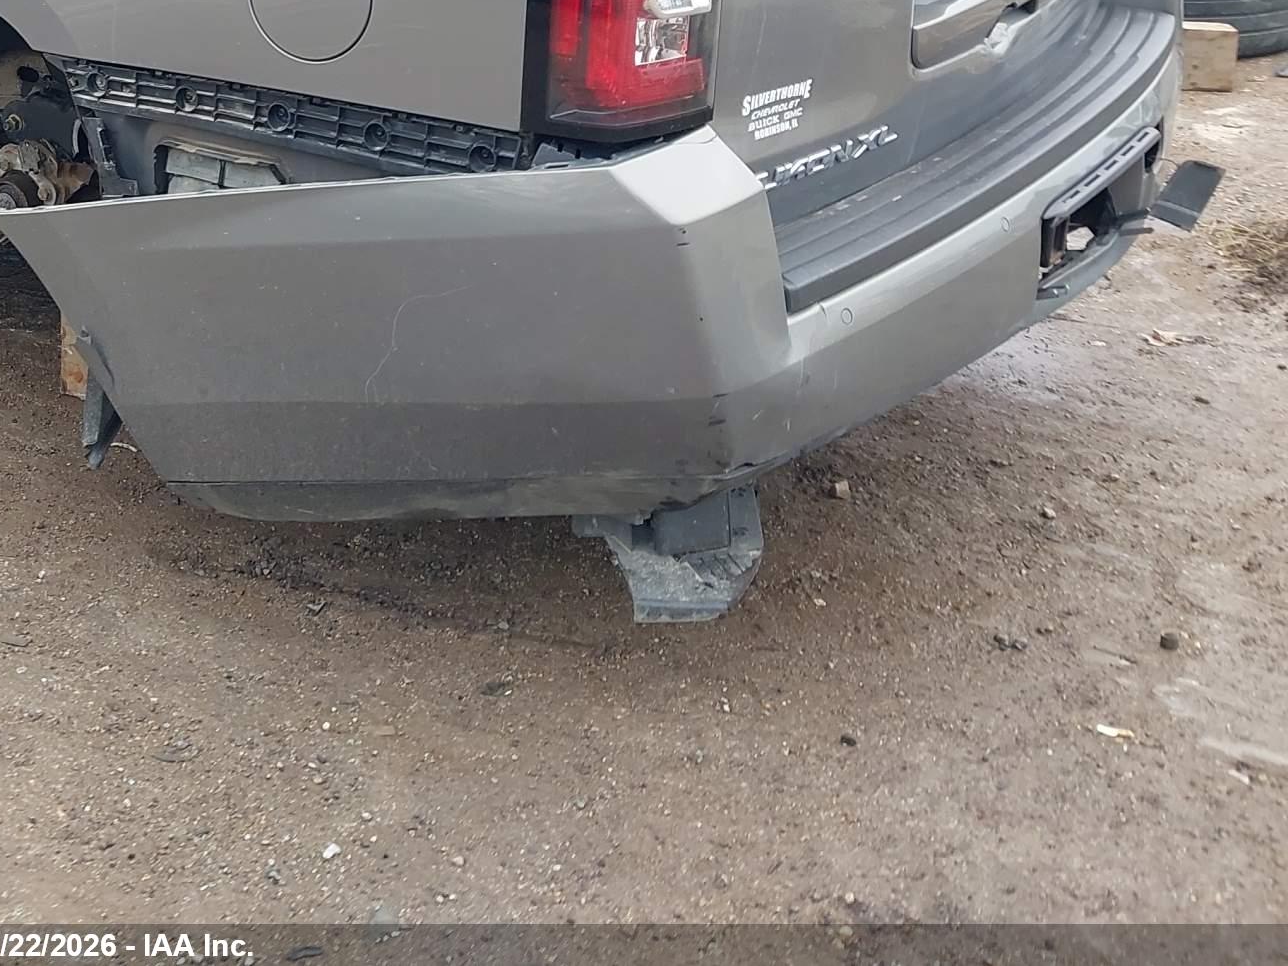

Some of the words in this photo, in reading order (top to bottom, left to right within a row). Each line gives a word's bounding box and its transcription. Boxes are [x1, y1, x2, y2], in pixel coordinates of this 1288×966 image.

[741, 78, 813, 116] SILVERTHORNE
[751, 98, 801, 120] CHEVROLET
[747, 114, 780, 132] BUICK
[783, 107, 803, 121] GMC
[755, 139, 853, 190] UKON
[852, 125, 898, 158] XL
